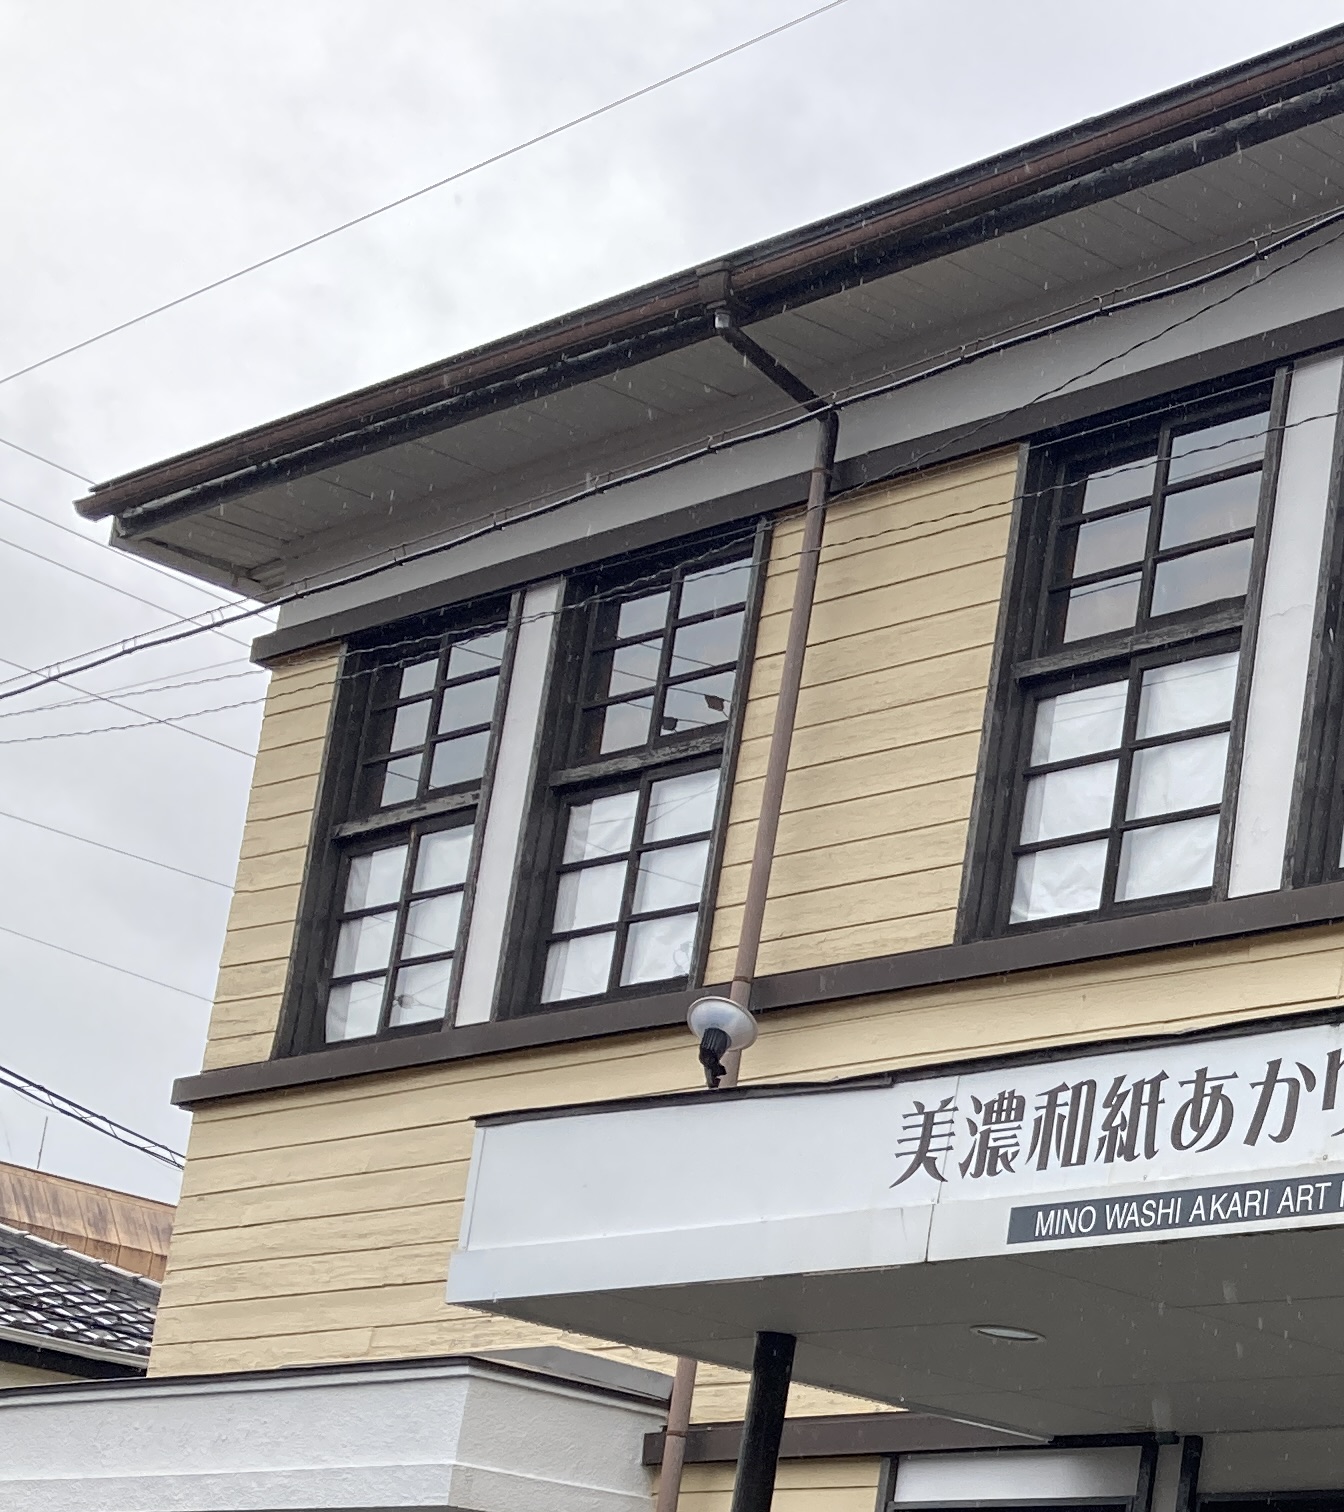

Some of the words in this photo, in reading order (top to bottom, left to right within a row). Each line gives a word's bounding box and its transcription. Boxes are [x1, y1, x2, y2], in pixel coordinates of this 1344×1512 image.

[1034, 1205, 1097, 1237] MINO
[1105, 1197, 1182, 1230] WASHI
[1188, 1188, 1270, 1222] AKARI
[1276, 1182, 1332, 1214] ART
